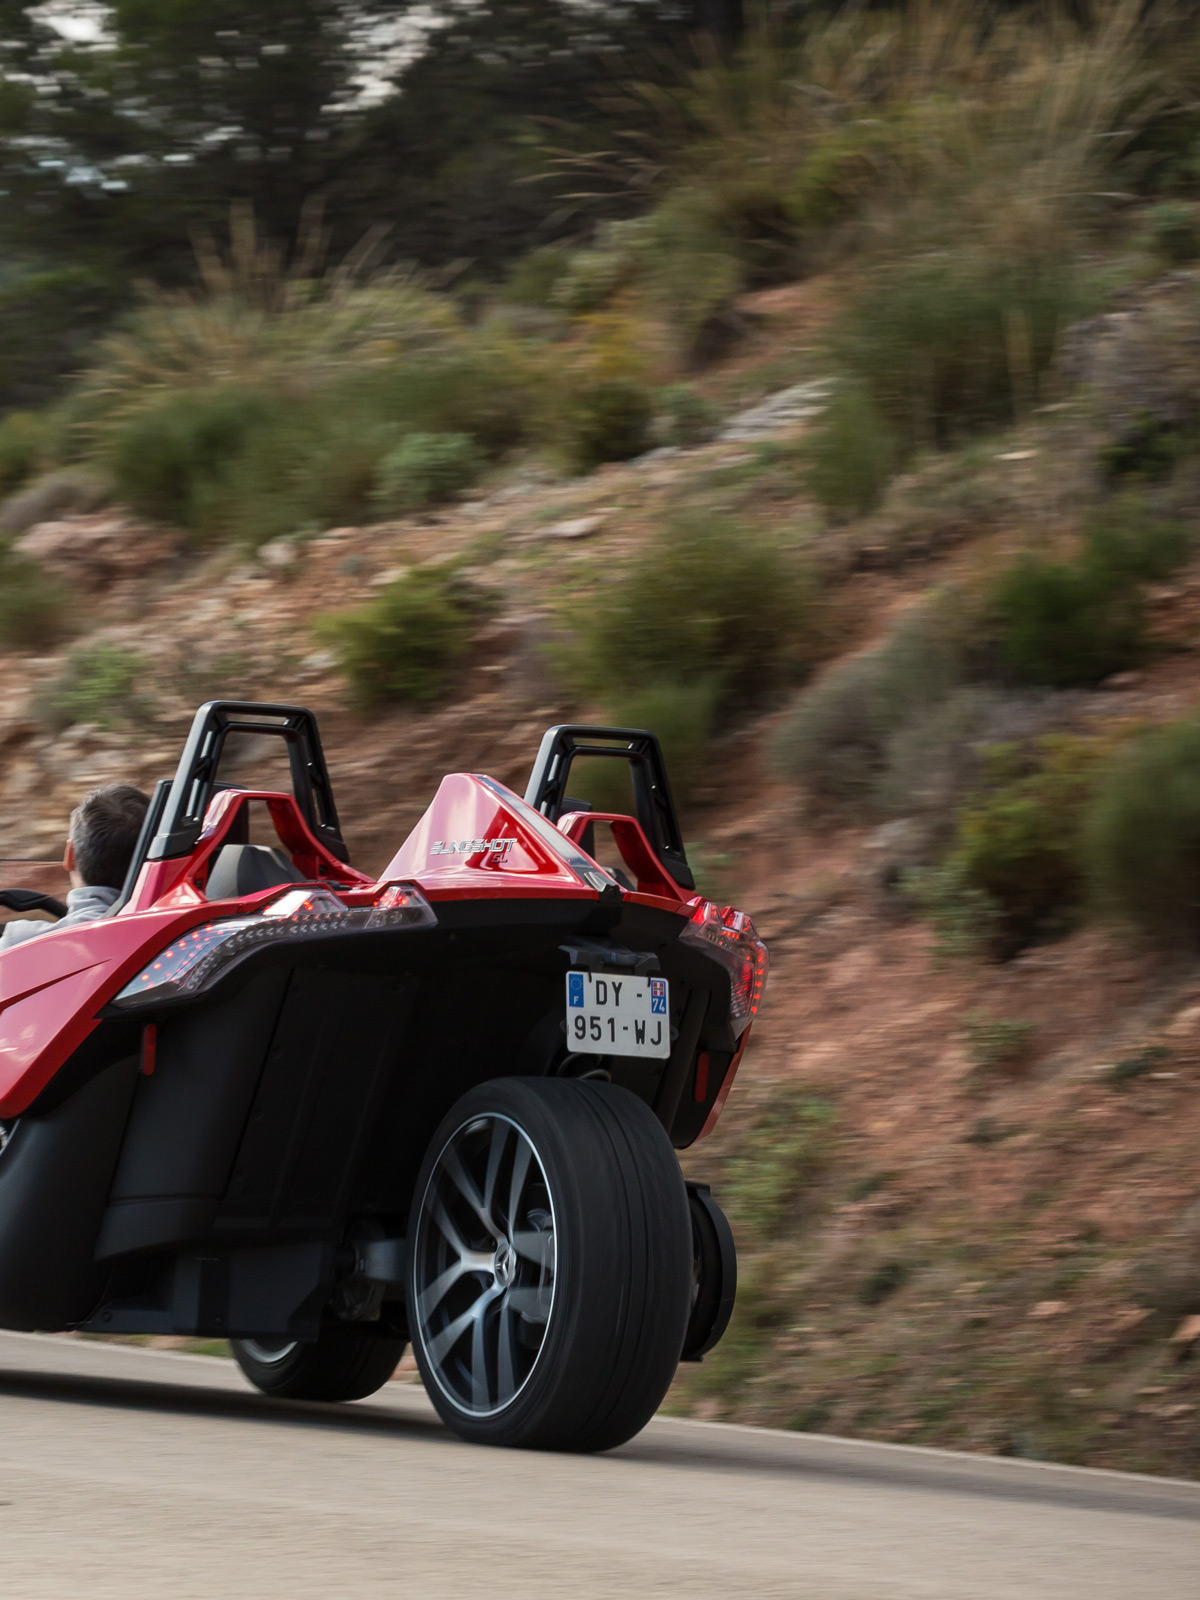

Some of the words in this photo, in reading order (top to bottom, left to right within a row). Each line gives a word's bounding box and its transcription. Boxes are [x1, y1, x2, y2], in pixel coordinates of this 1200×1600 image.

[430, 838, 517, 855] SLINGSHOT
[573, 996, 579, 1005] F
[652, 998, 665, 1012] 74
